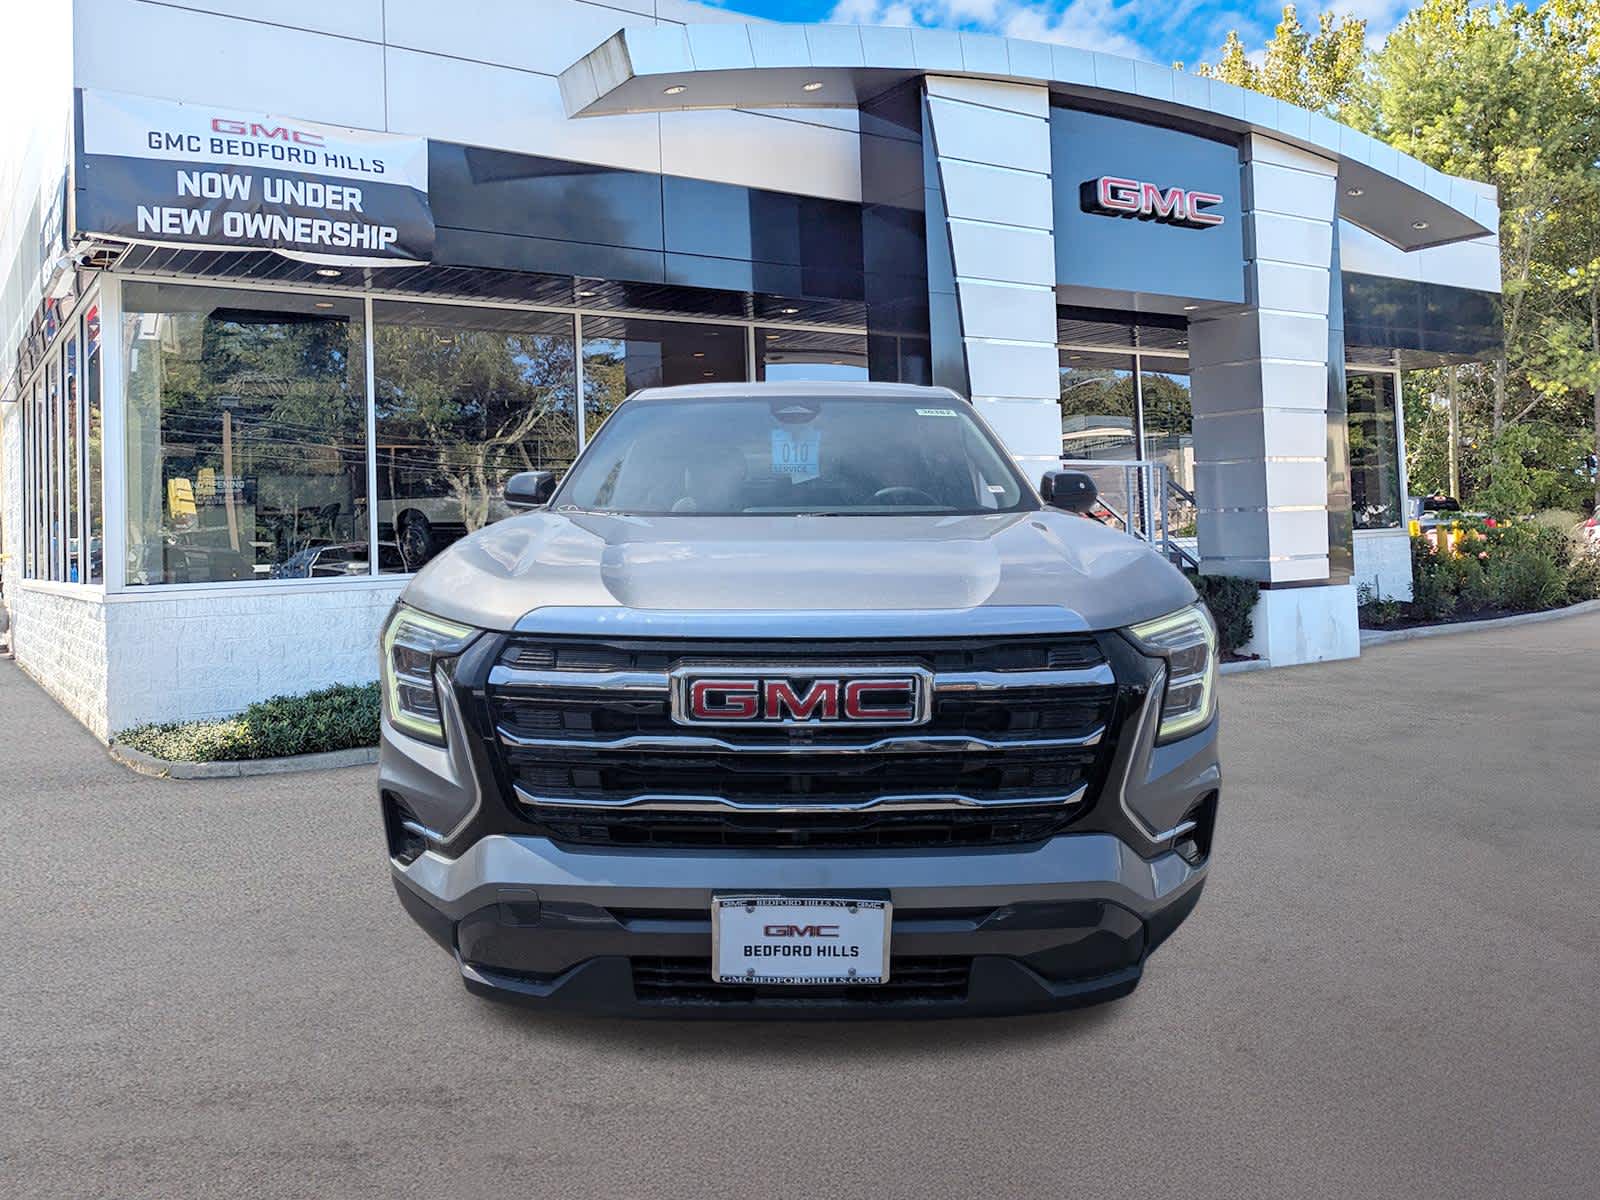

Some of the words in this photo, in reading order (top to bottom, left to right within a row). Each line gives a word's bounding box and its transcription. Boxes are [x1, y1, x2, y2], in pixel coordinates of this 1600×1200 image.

[148, 131, 201, 153] GMC
[210, 138, 316, 165] BEDFORD
[325, 153, 385, 174] HILLS
[212, 118, 326, 148] GMC
[177, 170, 252, 201] NOW
[263, 177, 363, 213] UNDER
[1097, 175, 1225, 225] GMC
[137, 206, 211, 236] NEW
[223, 211, 398, 250] OWNERSHIP
[690, 678, 914, 720] GMC
[743, 945, 811, 957] BEDFORD
[817, 945, 859, 957] HILLS
[763, 925, 840, 937] GMC
[721, 976, 880, 985] GMCBEDFORDHILLS.COM
